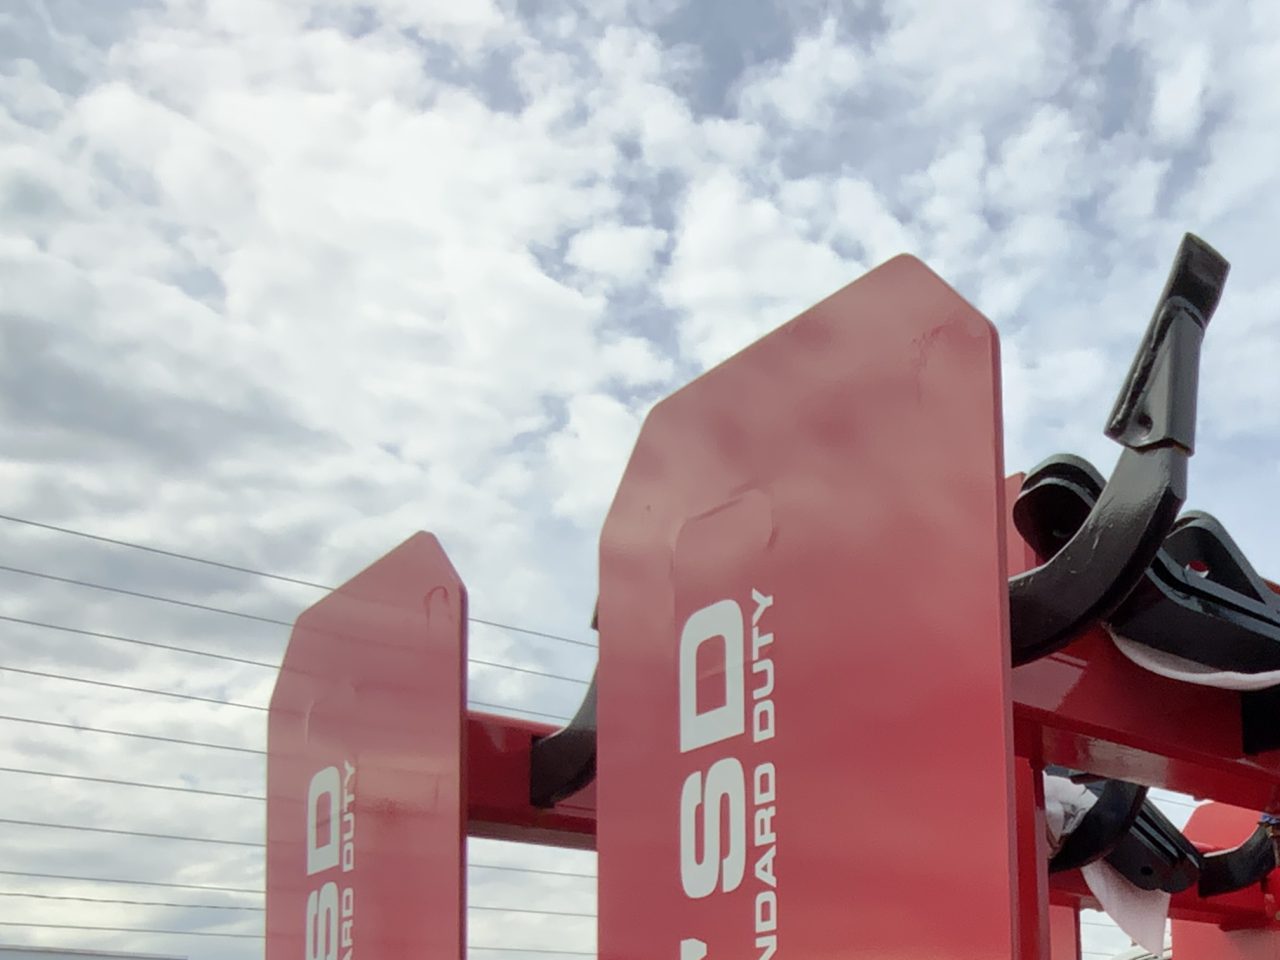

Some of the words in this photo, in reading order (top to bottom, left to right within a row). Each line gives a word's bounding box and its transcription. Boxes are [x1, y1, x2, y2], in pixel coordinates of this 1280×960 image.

[752, 588, 775, 743] DUTY
[343, 760, 356, 873] DUTY
[679, 599, 746, 899] SD
